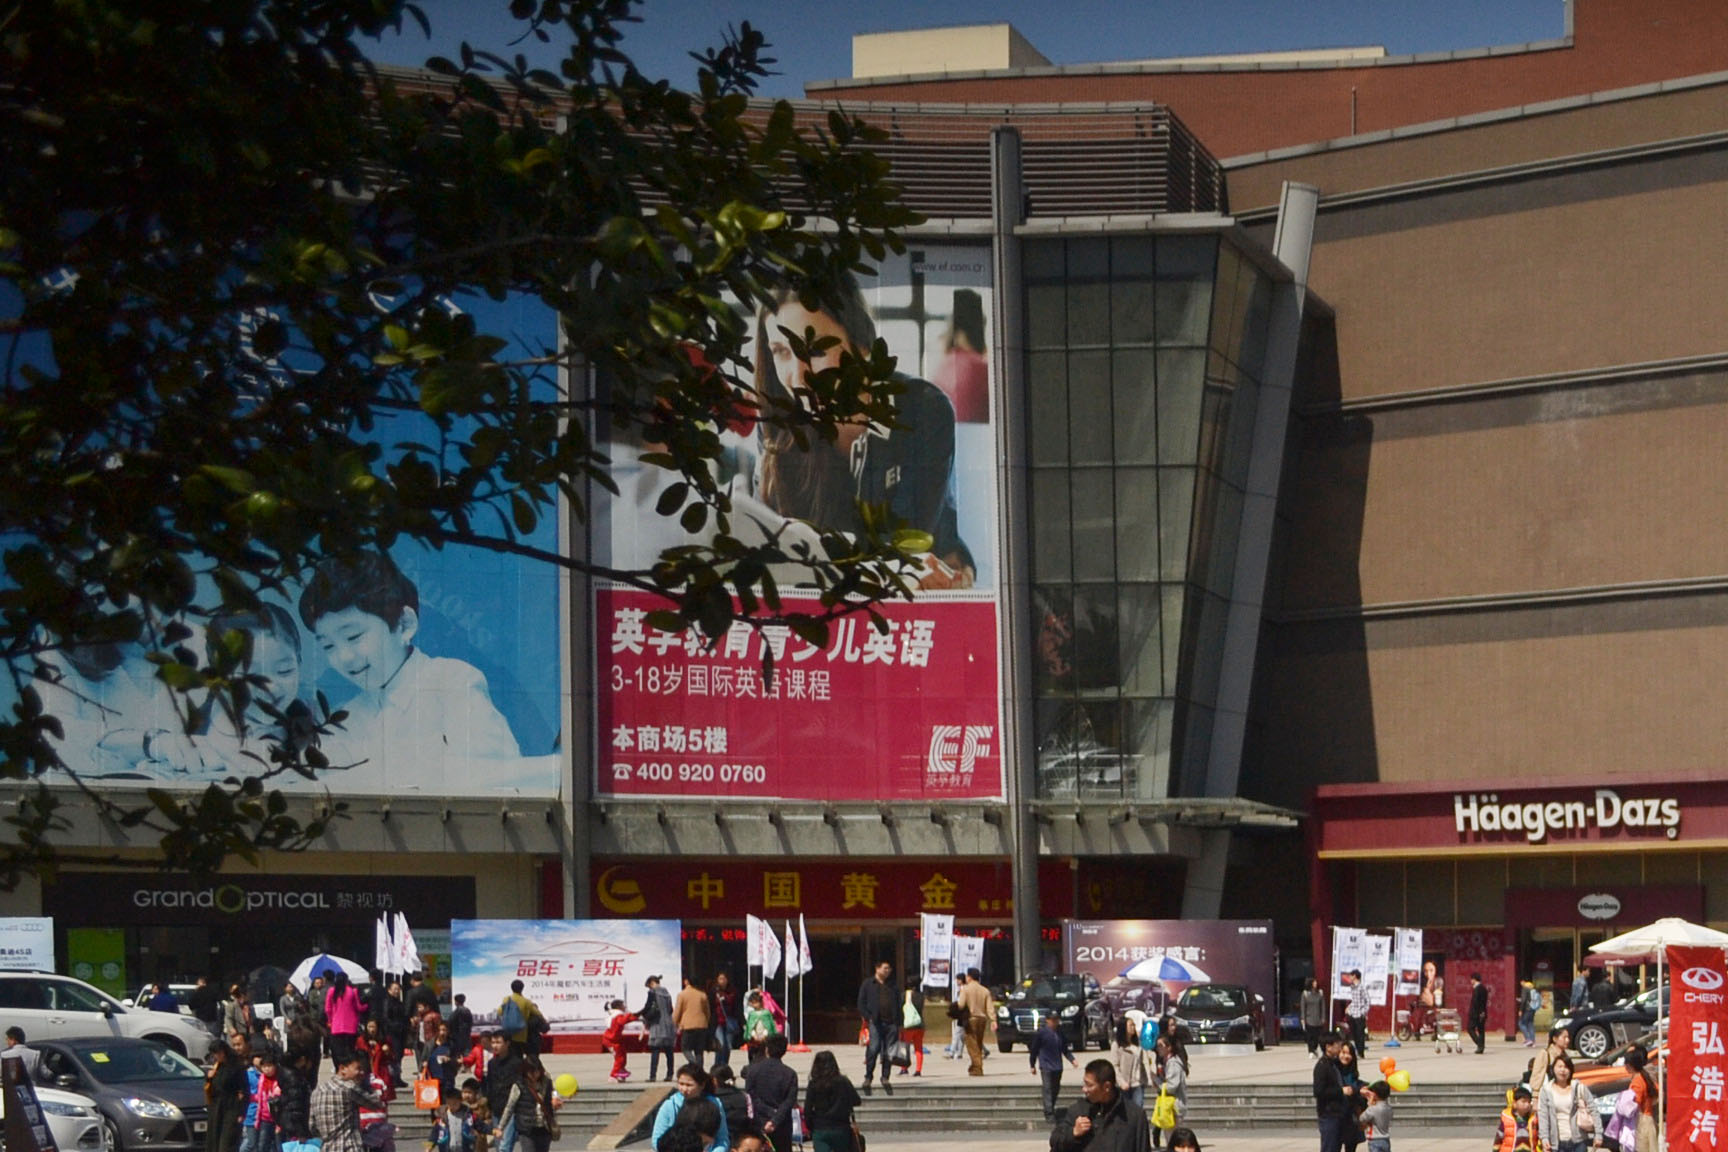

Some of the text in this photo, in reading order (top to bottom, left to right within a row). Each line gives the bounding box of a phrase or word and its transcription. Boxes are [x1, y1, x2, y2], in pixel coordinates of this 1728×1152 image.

[612, 724, 728, 755] 本商场5楼
[926, 725, 994, 773] EF
[637, 762, 766, 784] 400 920 0760
[1454, 790, 1681, 842] Häagen-Dazs
[686, 872, 958, 911] 中国黄金
[1684, 992, 1725, 1004] CHERY
